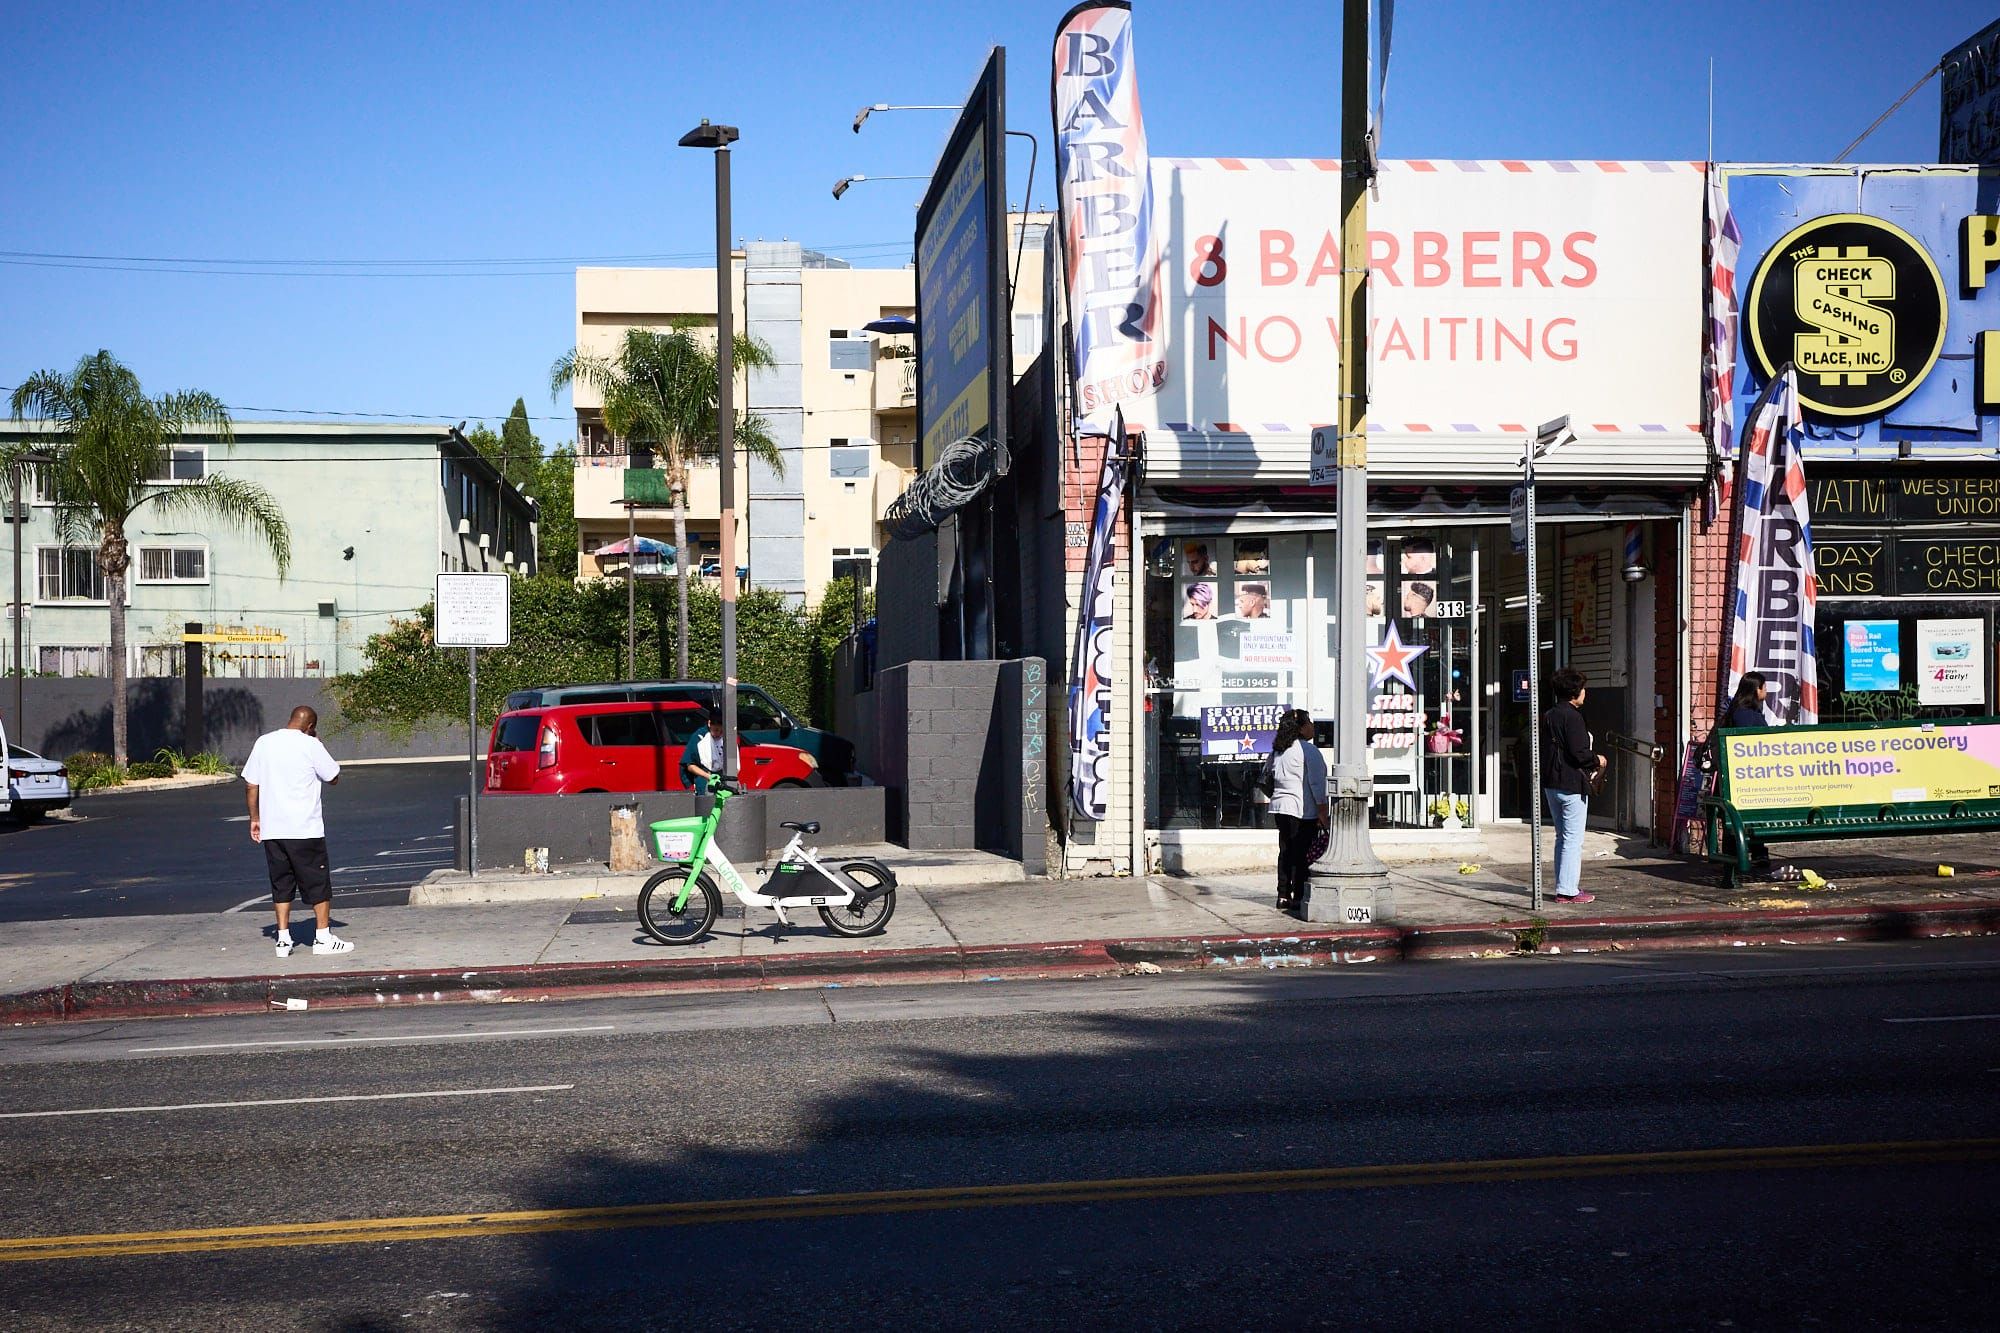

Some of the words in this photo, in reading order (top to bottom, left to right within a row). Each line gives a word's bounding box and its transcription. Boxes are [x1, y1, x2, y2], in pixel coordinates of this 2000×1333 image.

[1062, 32, 1153, 352] BARBER
[1190, 234, 1227, 287] 8
[1258, 230, 1598, 288] BARBERS
[1790, 244, 1816, 261] THE
[1816, 268, 1872, 281] CHECK
[1812, 298, 1880, 335] CASHING
[1207, 315, 1302, 363] NO
[1803, 352, 1852, 367] PLACE,
[1856, 352, 1885, 365] INC.
[1084, 360, 1169, 412] SHOP
[1926, 545, 2000, 567] CHEC
[1438, 602, 1463, 616] 313
[1247, 679, 1269, 687] 1945
[1934, 669, 1944, 682] 4
[1945, 673, 1968, 681] Early!
[1372, 694, 1413, 710] STAR
[1208, 708, 1222, 717] SE
[1226, 706, 1285, 716] SOLICITA
[1371, 733, 1415, 749] SHOP
[1733, 739, 1837, 758] Substance
[1842, 740, 1876, 753] use
[1881, 736, 1967, 752] recovery
[1735, 763, 1795, 779] starts
[1799, 759, 1841, 776] with
[1845, 759, 1902, 776] hope.
[719, 860, 744, 892] Lime
